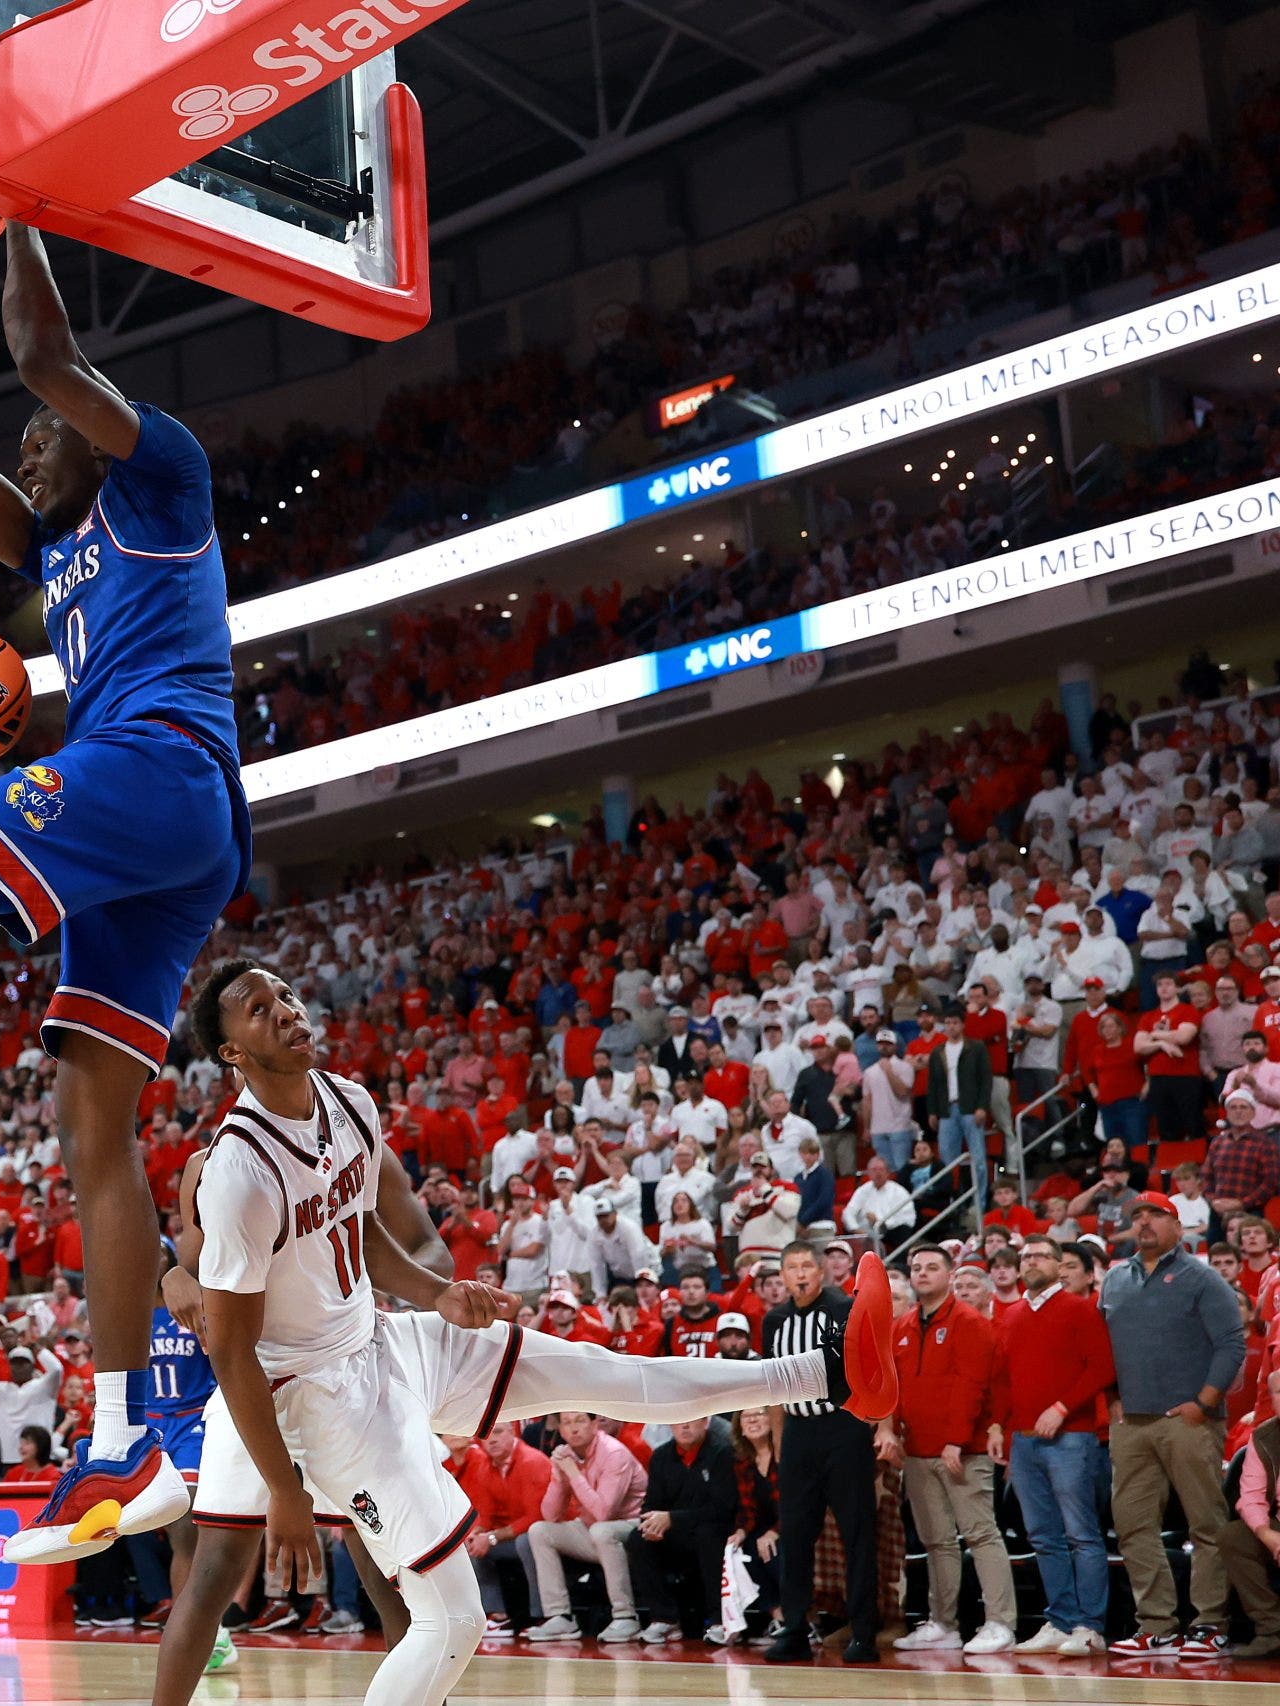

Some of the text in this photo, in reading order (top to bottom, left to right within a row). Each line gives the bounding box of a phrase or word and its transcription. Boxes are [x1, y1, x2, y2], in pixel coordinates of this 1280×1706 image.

[805, 420, 851, 452] IT'S
[861, 346, 1071, 435] ENROLLMENT
[1082, 299, 1227, 363] SEASON.
[688, 456, 732, 495] NC
[42, 543, 101, 628] ANSAS
[852, 595, 901, 628] IT'S
[912, 529, 1137, 612] ENROLLMENT
[727, 628, 772, 666] NC
[27, 790, 46, 808] KU
[294, 1151, 365, 1239] NC STATE
[326, 1212, 362, 1301] 11
[149, 1338, 196, 1357] ANSAS
[151, 1363, 182, 1399] 11
